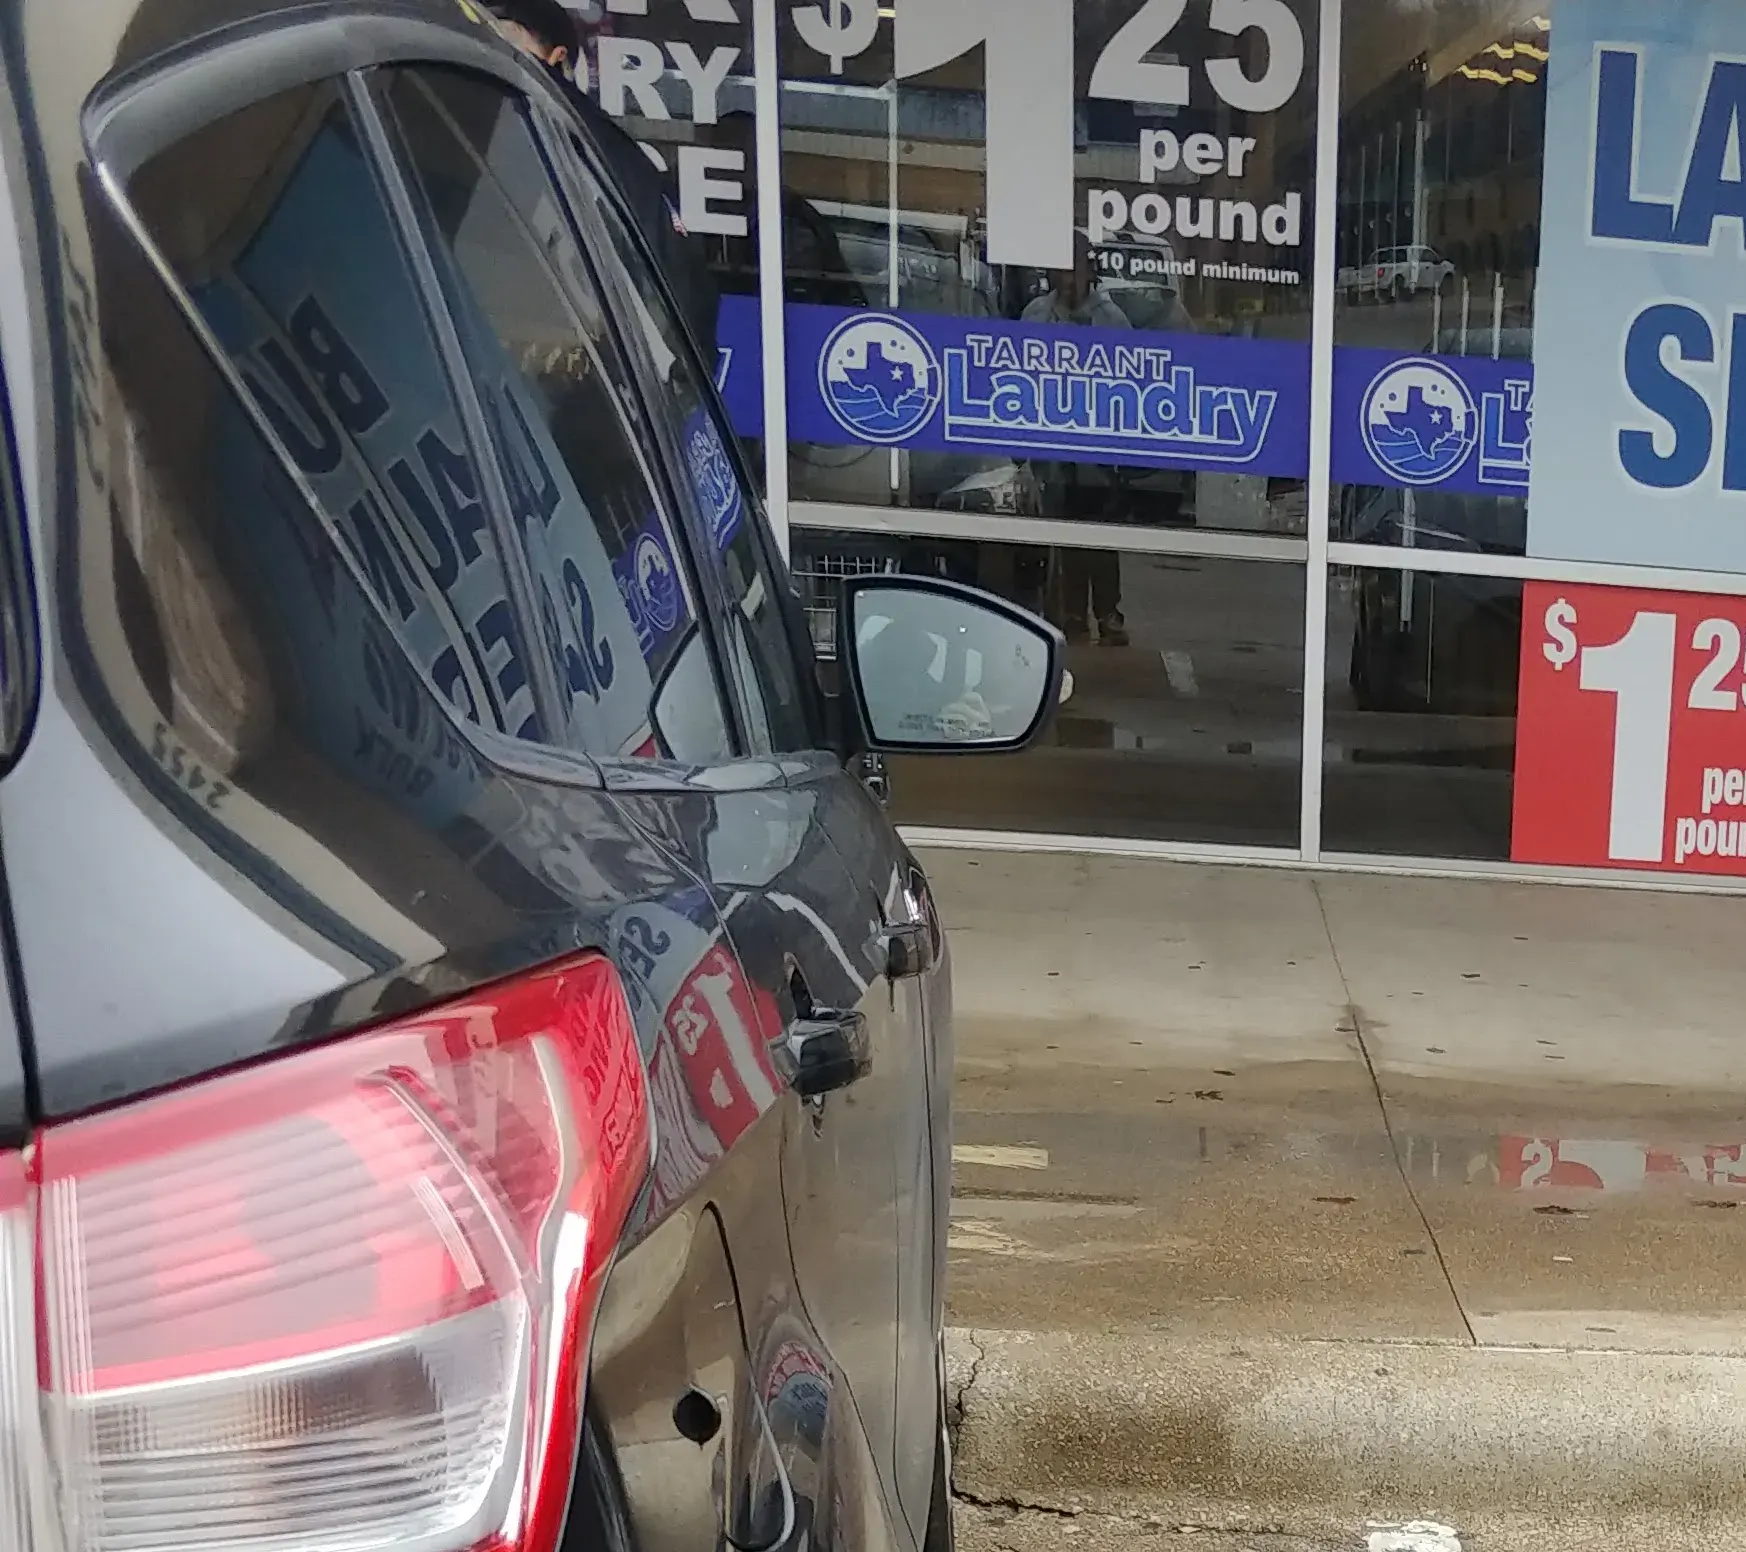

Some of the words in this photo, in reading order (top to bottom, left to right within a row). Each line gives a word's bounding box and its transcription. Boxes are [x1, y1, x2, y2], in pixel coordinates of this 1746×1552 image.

[575, 36, 741, 124] RY
[1139, 127, 1257, 183] per
[1088, 188, 1301, 246] pound
[1130, 258, 1195, 276] pound
[1202, 262, 1300, 284] minimum
[966, 334, 1171, 380] TARRANT
[944, 348, 1277, 450] Laundry
